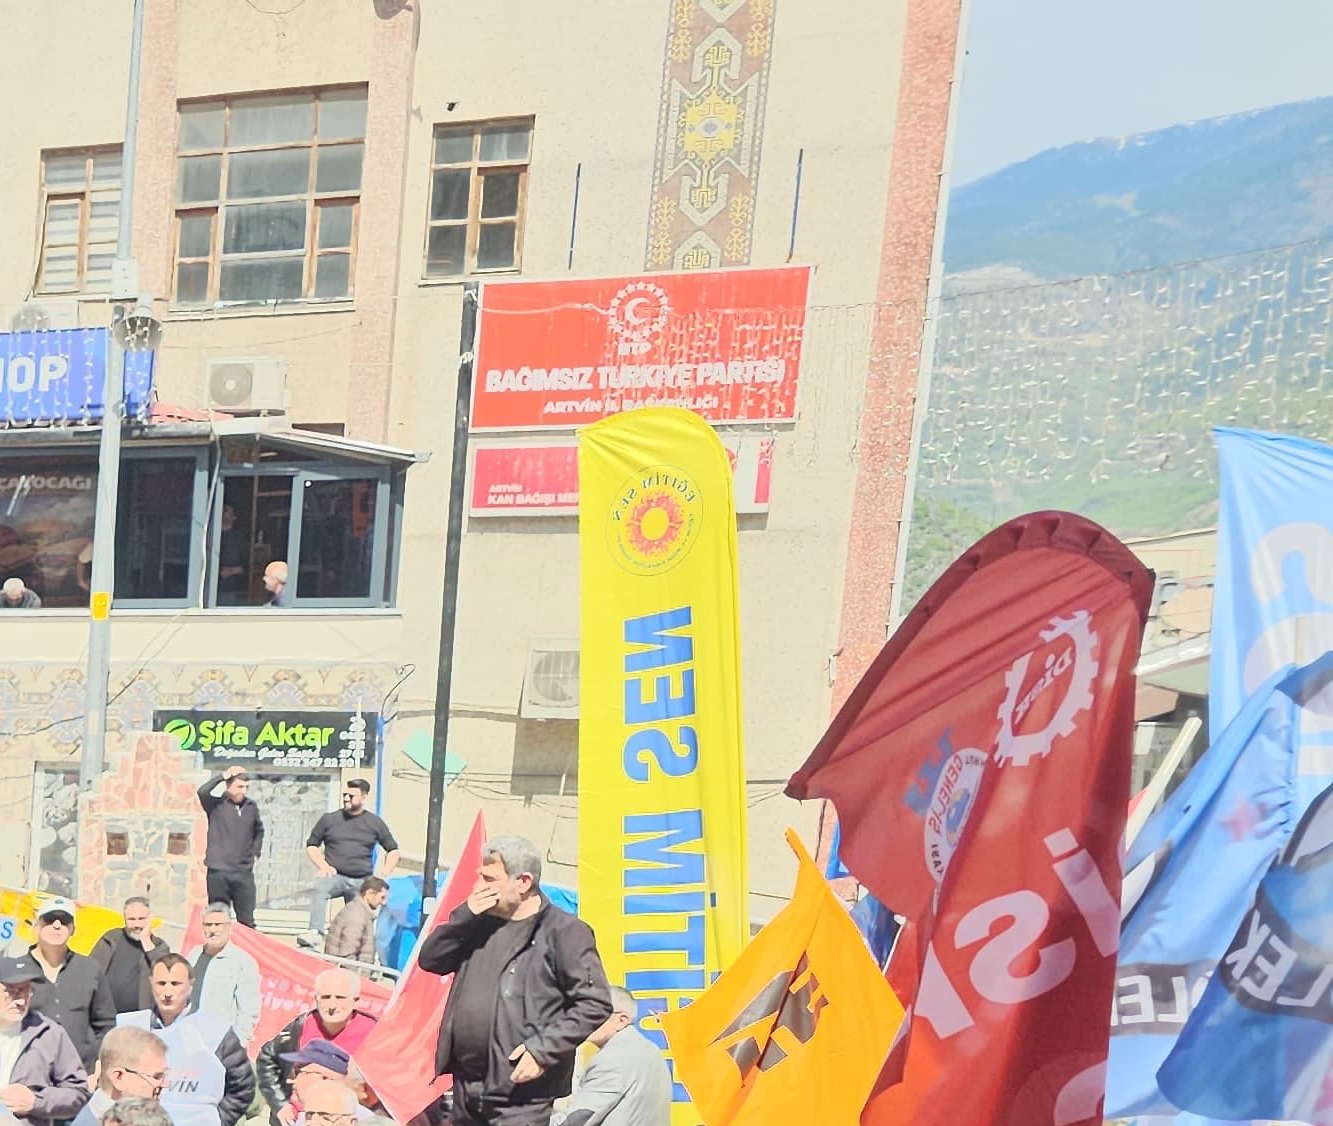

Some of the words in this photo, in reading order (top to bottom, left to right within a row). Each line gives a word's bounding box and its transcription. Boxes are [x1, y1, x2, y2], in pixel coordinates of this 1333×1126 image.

[485, 366, 593, 394] BAĞIMSIZ
[598, 363, 693, 390] TÜRKİYE
[487, 494, 515, 506] KAN
[199, 719, 250, 751] Şifa
[256, 720, 334, 746] Aktar
